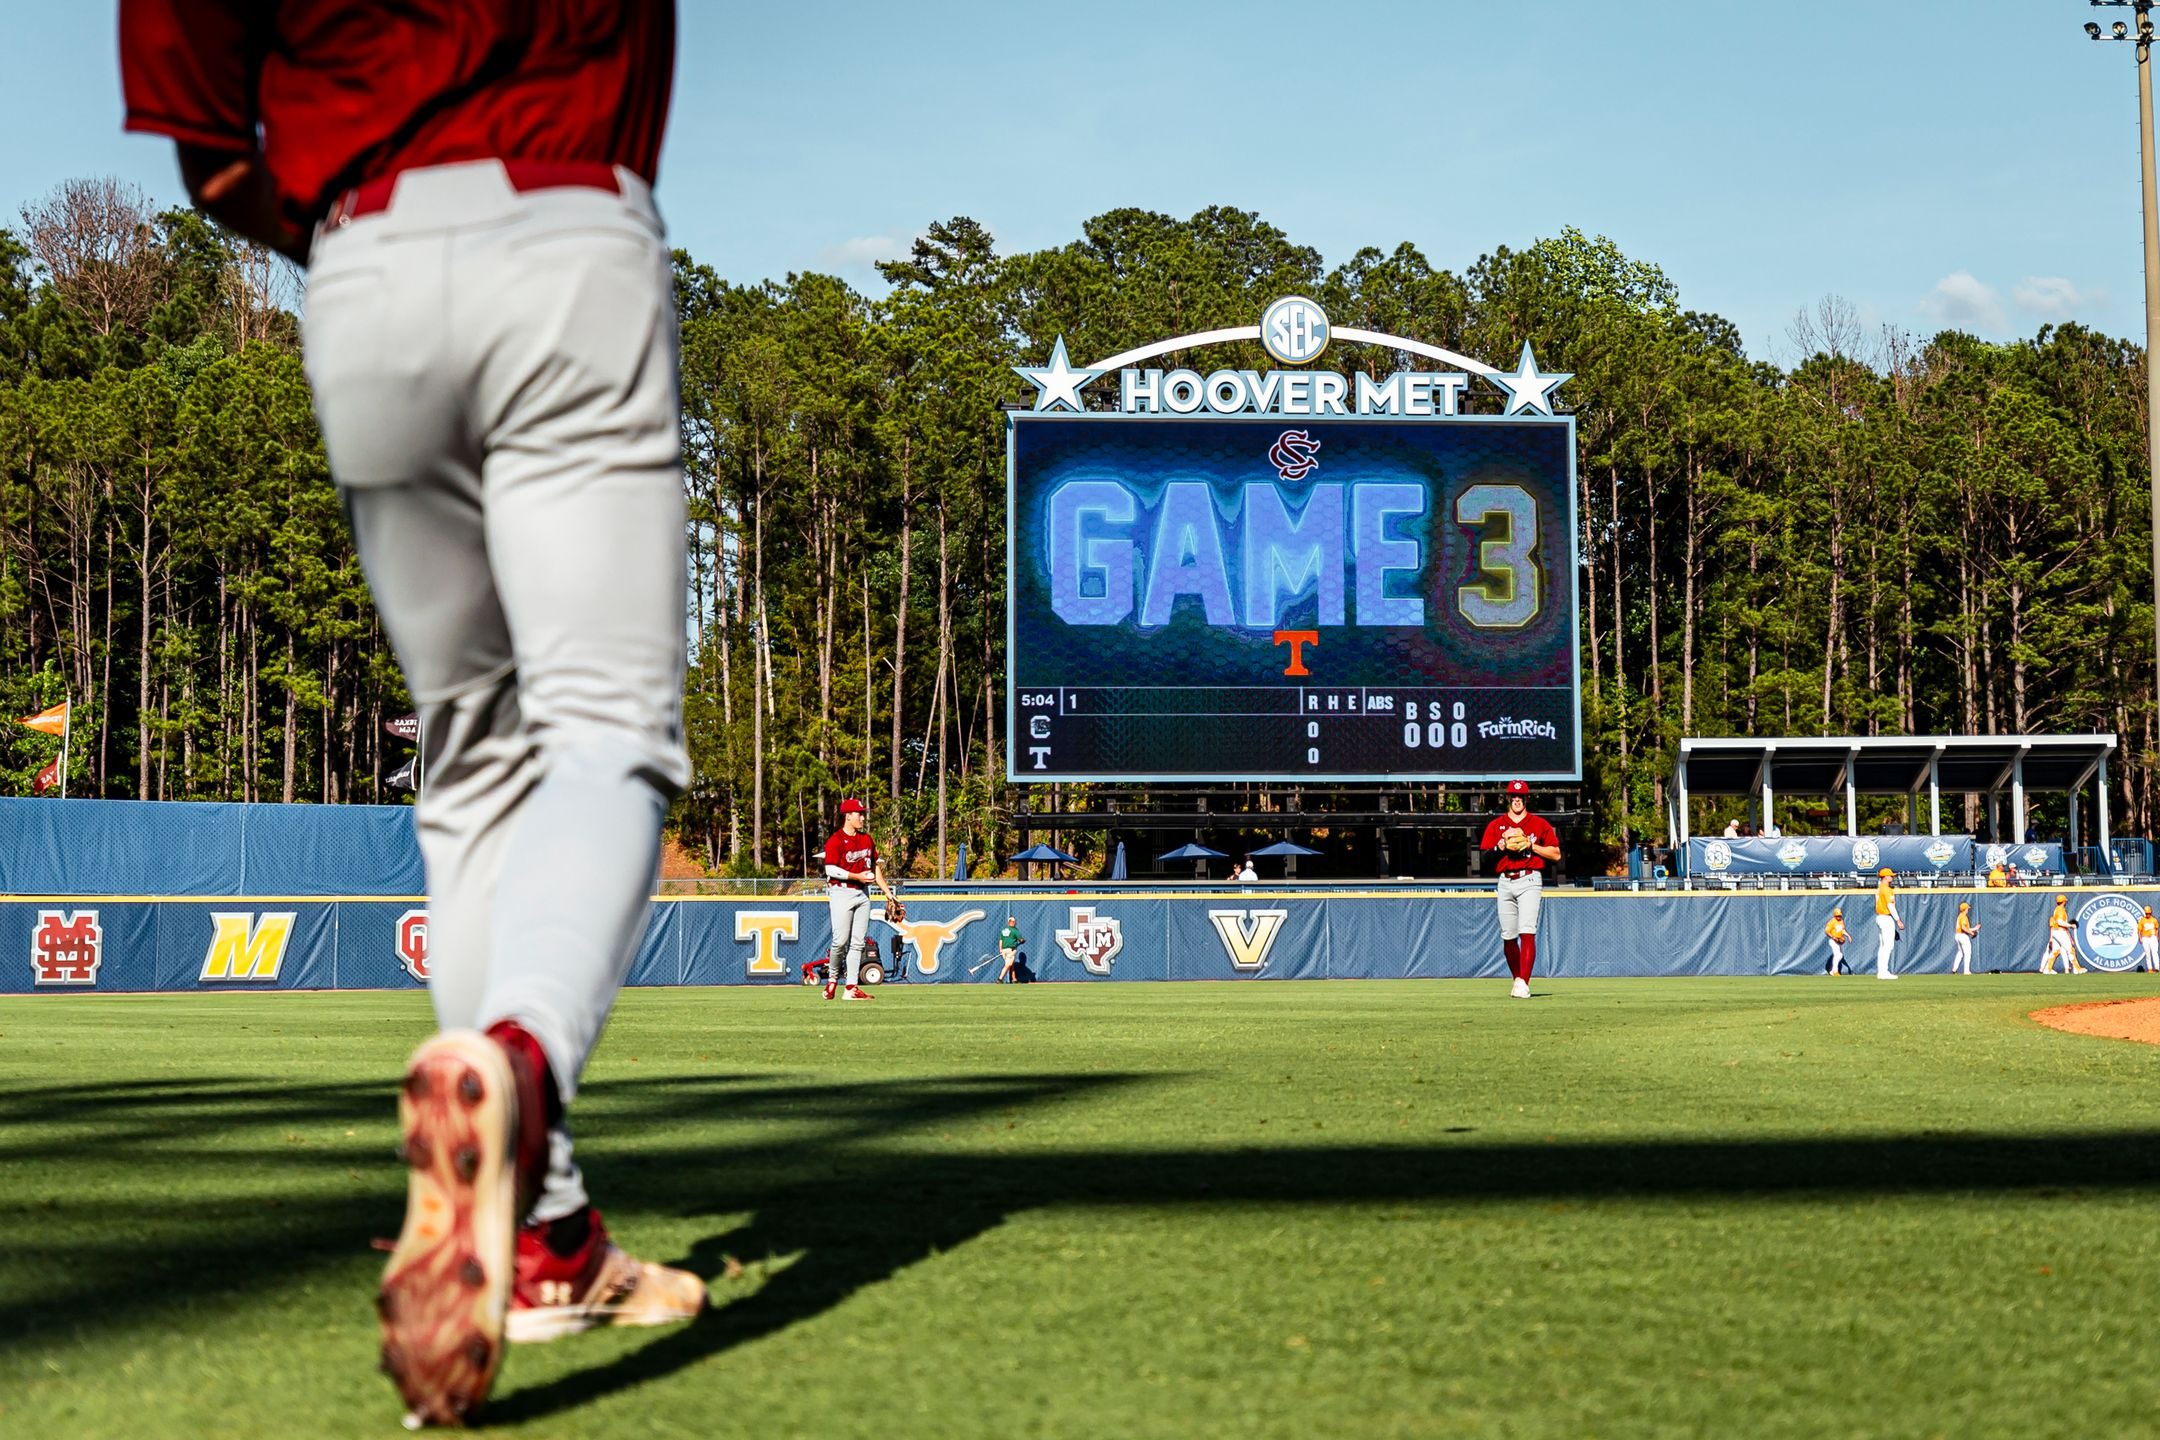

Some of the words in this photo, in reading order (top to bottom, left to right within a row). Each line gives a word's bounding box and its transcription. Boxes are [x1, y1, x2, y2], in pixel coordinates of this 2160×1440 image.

[1270, 304, 1322, 358] SEC
[1125, 373, 1345, 414] HOOVER
[1360, 375, 1465, 415] MET
[1050, 481, 1425, 626] GAME
[1457, 484, 1539, 627] 3
[1273, 630, 1319, 676] T
[1021, 694, 1054, 706] 5:04
[1069, 694, 1077, 709] 1
[1308, 695, 1319, 710] R
[1328, 695, 1339, 710] H
[1348, 695, 1357, 710] E
[1367, 695, 1394, 710] ABS
[1406, 702, 1418, 720] B
[1429, 702, 1441, 720] S
[1030, 715, 1051, 739] C
[1307, 721, 1319, 738] 0
[1404, 722, 1421, 748] 0
[1428, 722, 1445, 748] 0
[1451, 722, 1467, 748] 0
[1029, 746, 1051, 769] T
[1307, 747, 1319, 764] 0
[2082, 903, 2097, 920] CITY
[2099, 899, 2111, 907] OF
[198, 912, 297, 980] M
[735, 911, 799, 975] T
[1208, 909, 1287, 968] V
[2093, 955, 2134, 967] ALABAMA
